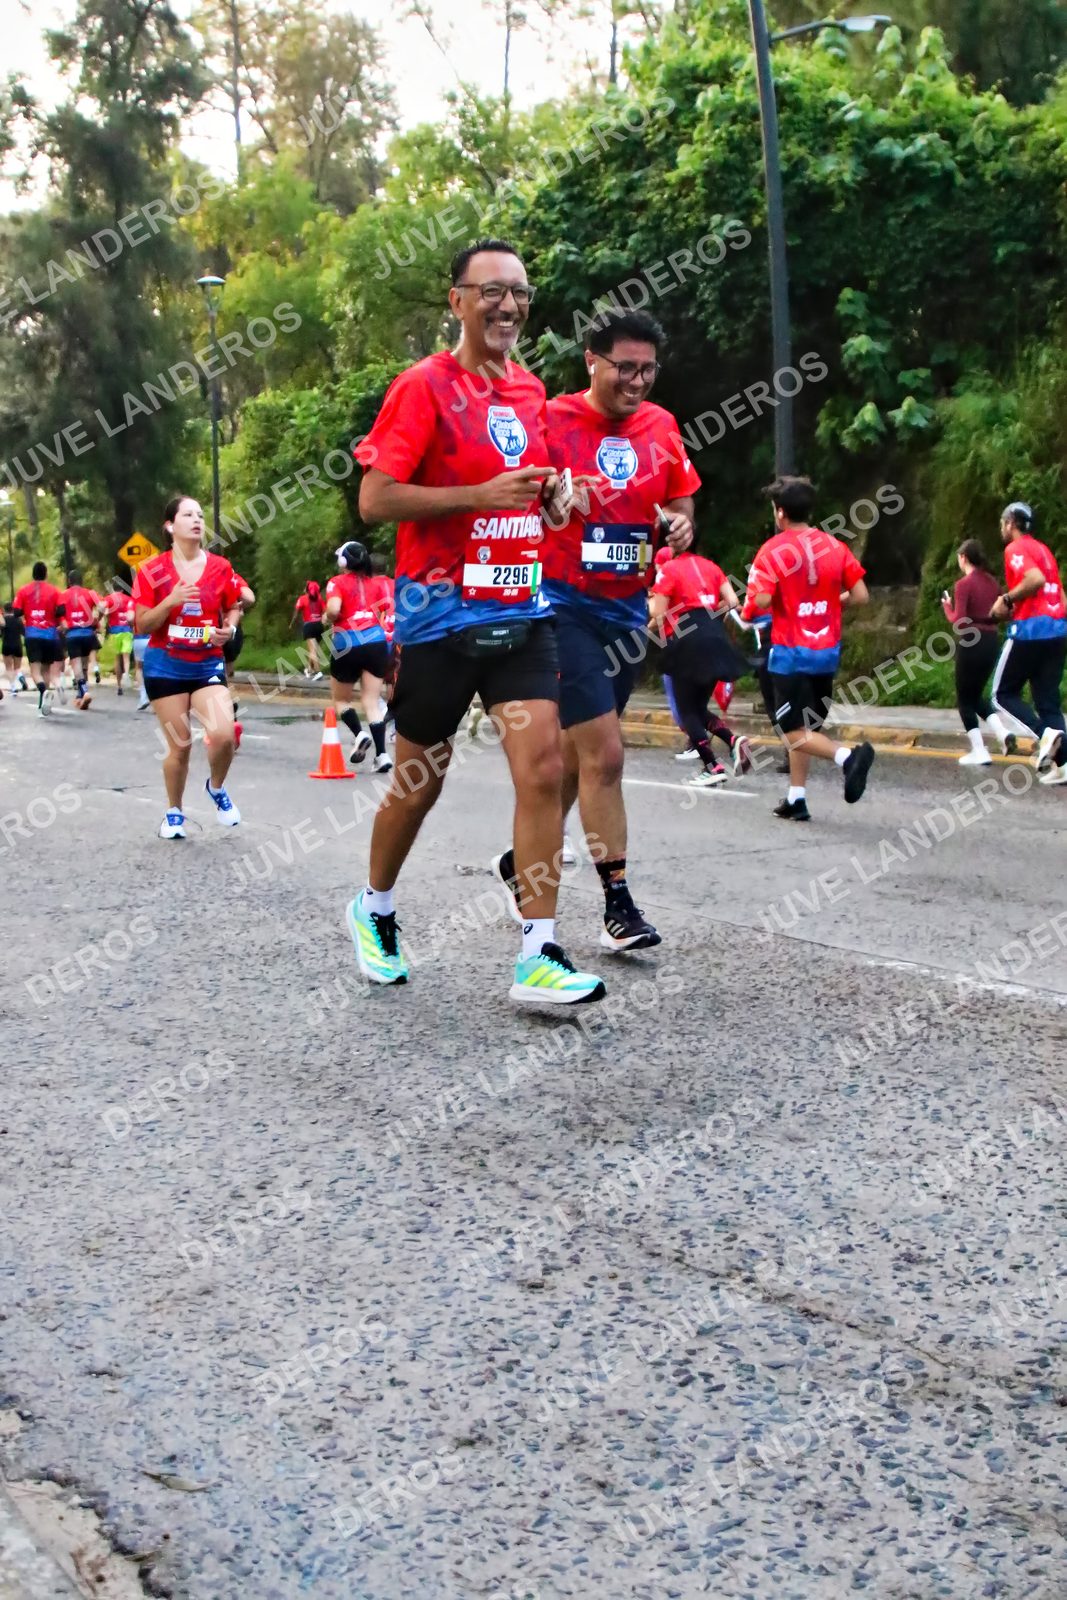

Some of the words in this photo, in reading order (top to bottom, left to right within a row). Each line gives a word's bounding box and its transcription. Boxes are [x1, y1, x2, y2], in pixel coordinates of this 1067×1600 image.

[607, 545, 638, 561] 4095
[493, 566, 528, 585] 2296
[184, 628, 204, 638] 2219
